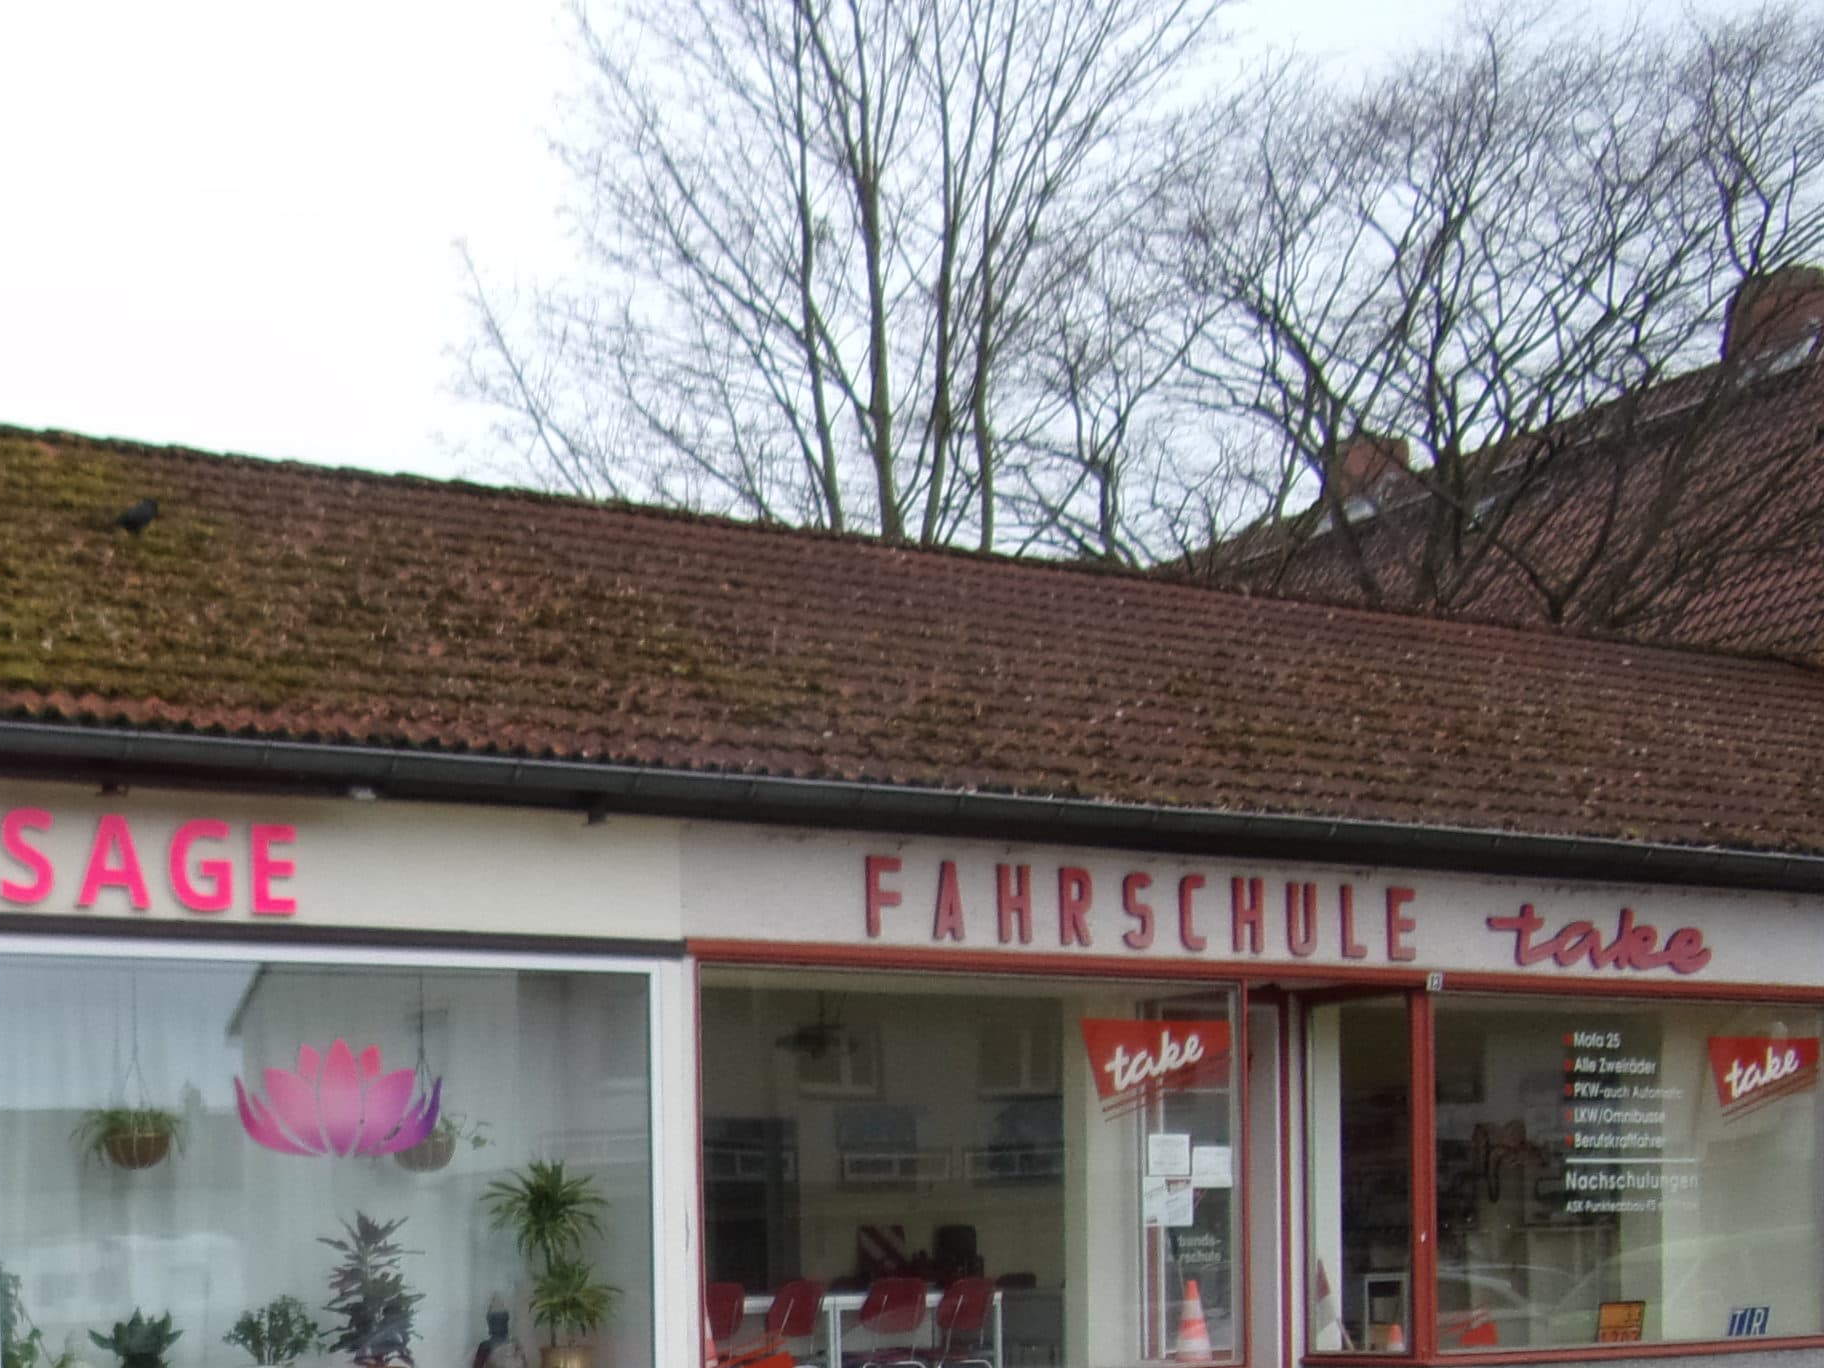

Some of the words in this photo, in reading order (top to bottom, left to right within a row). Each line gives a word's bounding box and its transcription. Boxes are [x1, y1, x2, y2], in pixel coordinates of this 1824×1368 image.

[863, 854, 1418, 963] FAHRSCHULE
[1485, 901, 1713, 976] take
[1573, 1031, 1604, 1048] Mofa
[1606, 1032, 1622, 1049] 25
[1103, 1029, 1205, 1092] take
[1573, 1057, 1597, 1073] Alle
[1722, 1045, 1800, 1099] take
[1565, 1169, 1699, 1194] Nachschulungen
[1731, 1308, 1766, 1336] TIR
